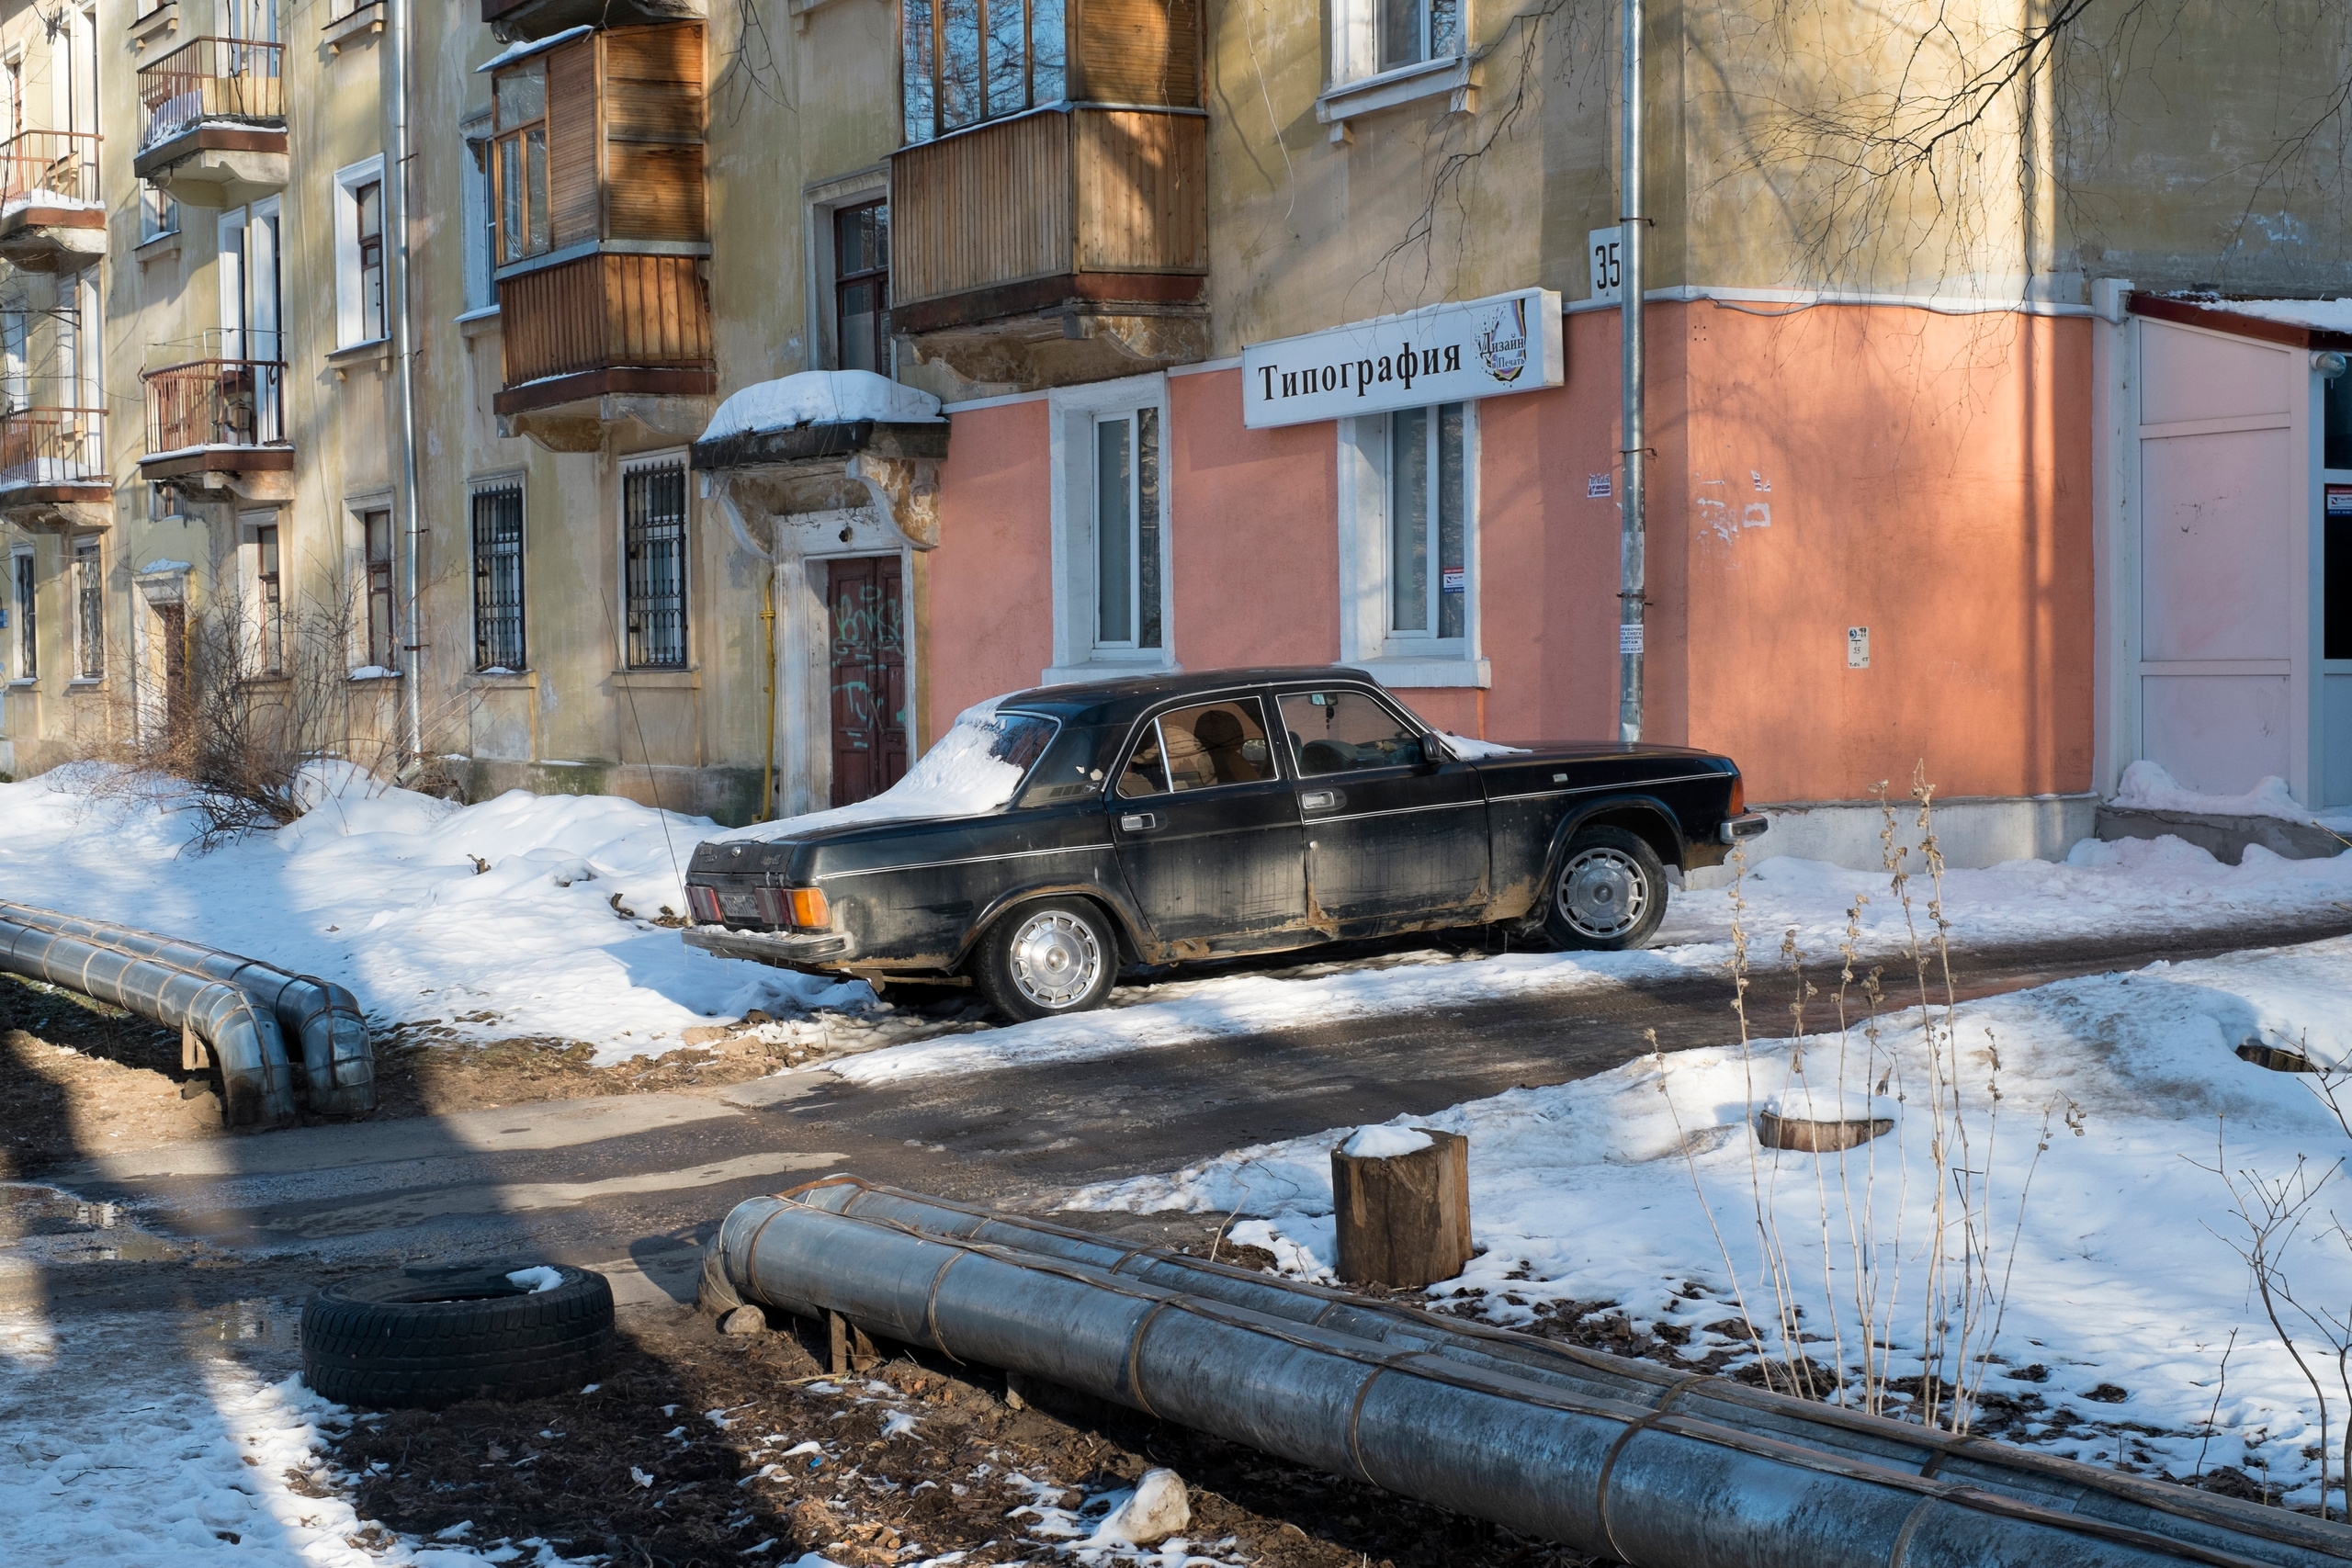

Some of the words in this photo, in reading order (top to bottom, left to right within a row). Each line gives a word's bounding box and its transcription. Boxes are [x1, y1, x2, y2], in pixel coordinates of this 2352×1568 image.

[1595, 242, 1620, 290] 35
[1479, 332, 1524, 360] Дизайн
[1491, 361, 1497, 369] и
[1498, 355, 1525, 368] Печать
[1258, 342, 1461, 401] Типография
